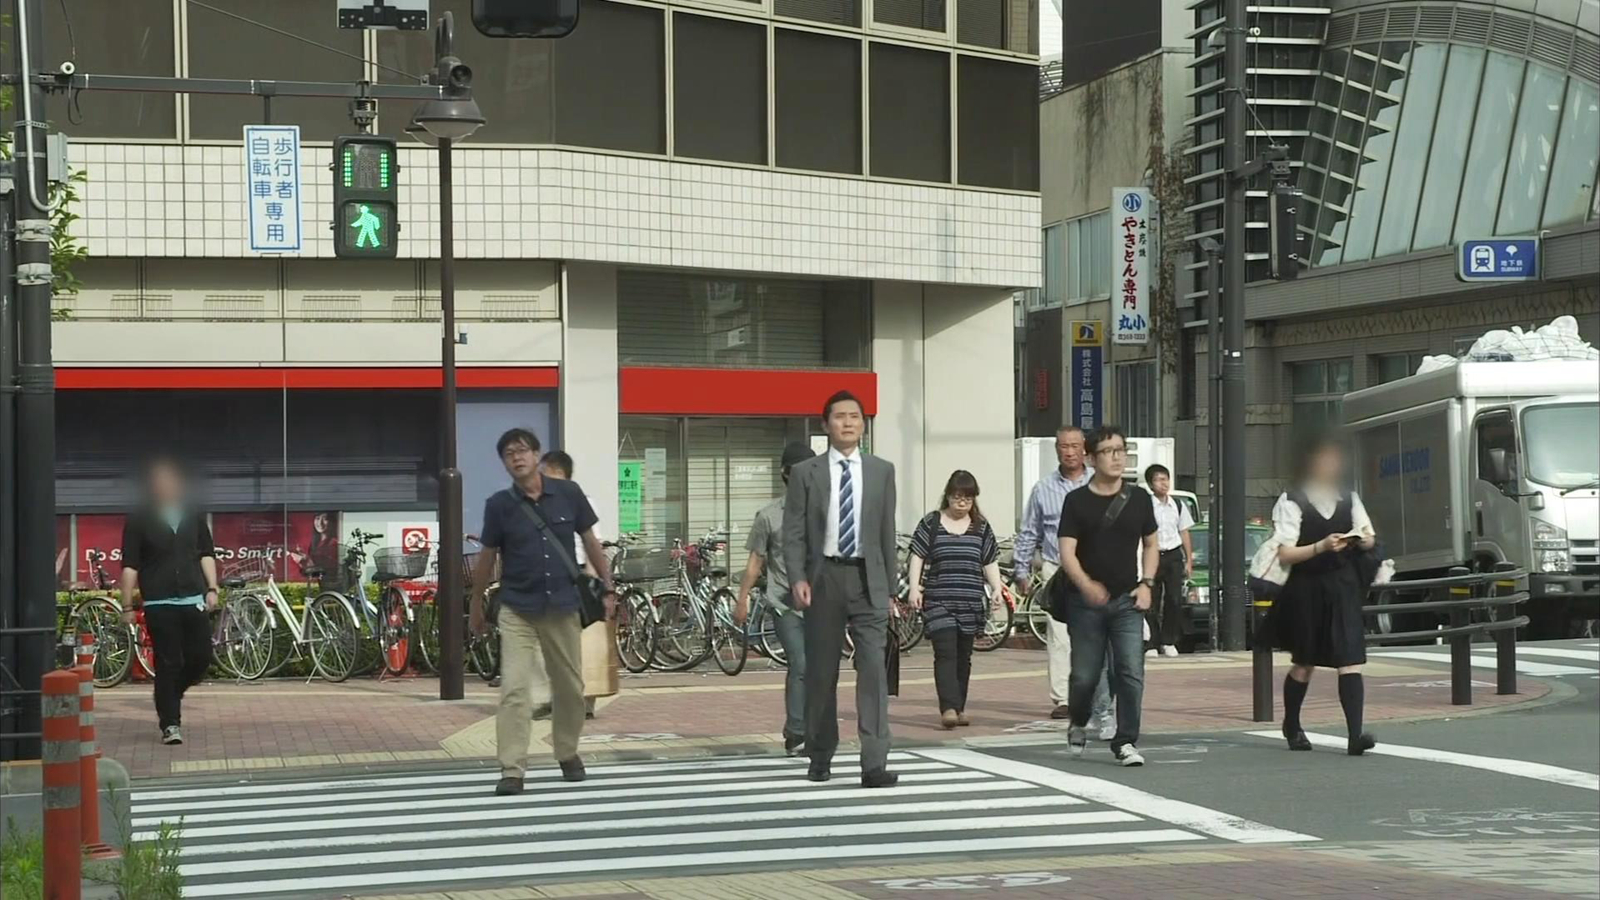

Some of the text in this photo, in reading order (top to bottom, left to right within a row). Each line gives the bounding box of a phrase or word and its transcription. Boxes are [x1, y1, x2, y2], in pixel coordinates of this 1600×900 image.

[252, 137, 272, 199] 自転車
[274, 137, 294, 199] 歩行者
[265, 202, 284, 242] 専用
[1121, 216, 1138, 310] やきとん専門
[237, 547, 282, 559] Smrt
